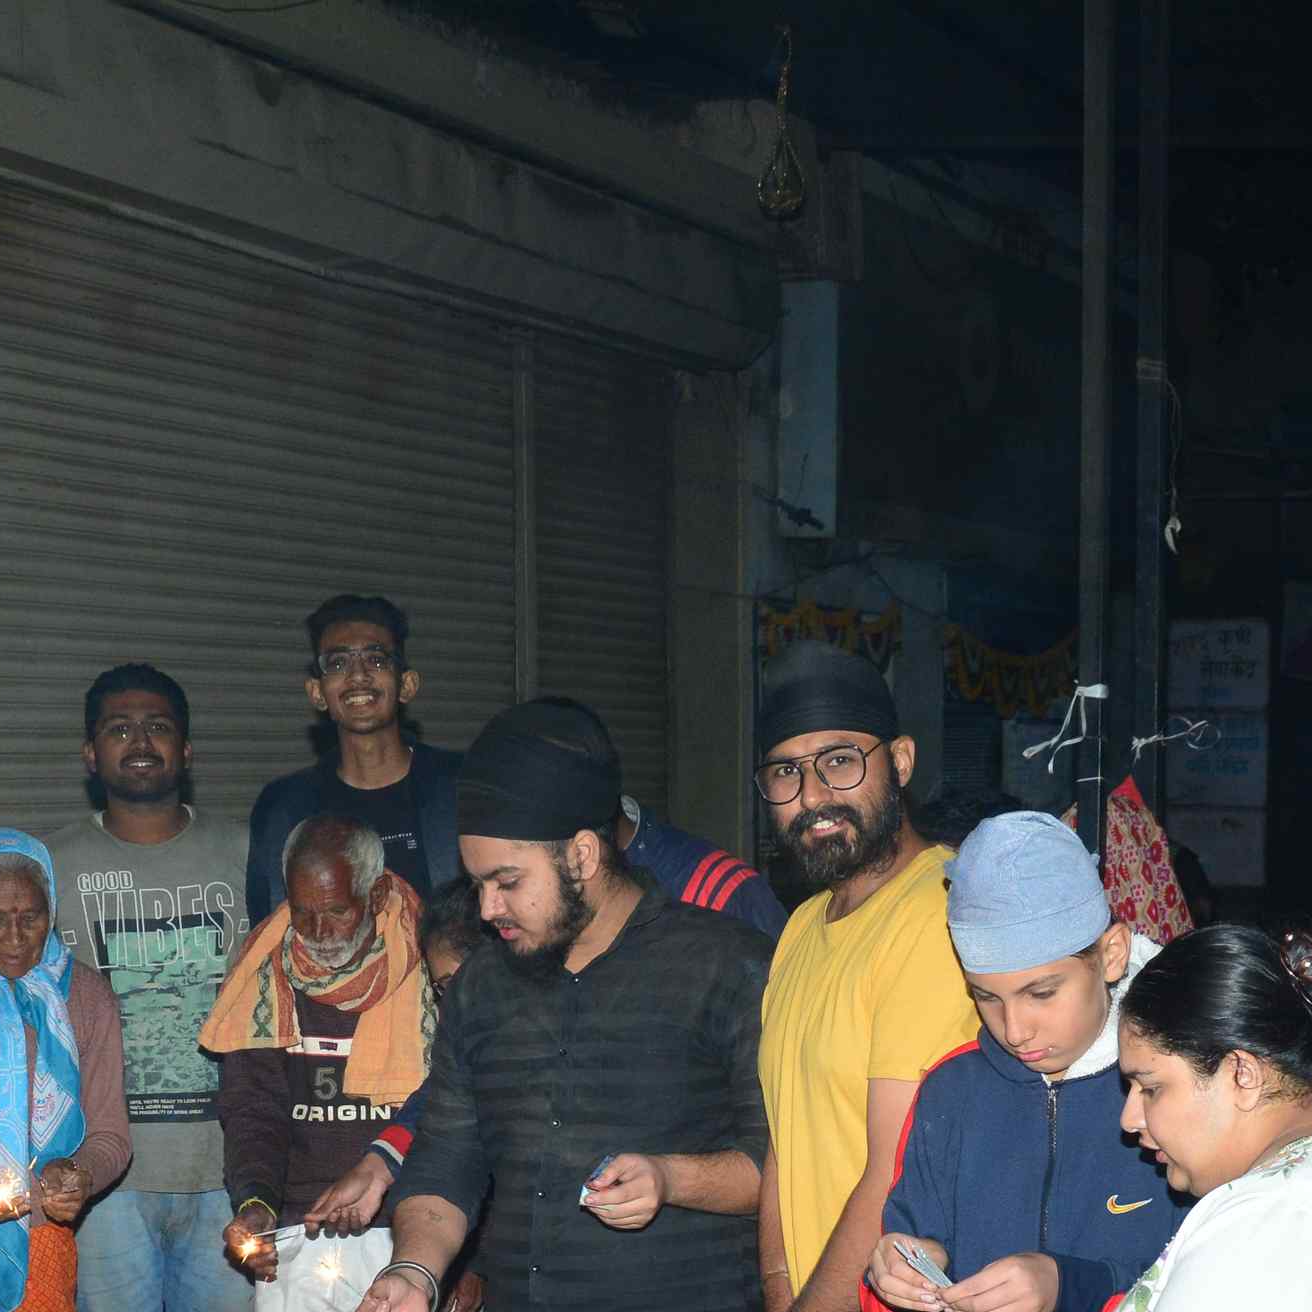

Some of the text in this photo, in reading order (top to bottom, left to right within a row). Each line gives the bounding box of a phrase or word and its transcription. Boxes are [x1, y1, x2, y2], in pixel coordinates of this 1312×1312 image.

[77, 870, 134, 892] GOOD
[80, 881, 234, 969] VIBES
[312, 1066, 338, 1100] 5
[291, 1103, 391, 1122] ORIGIN
